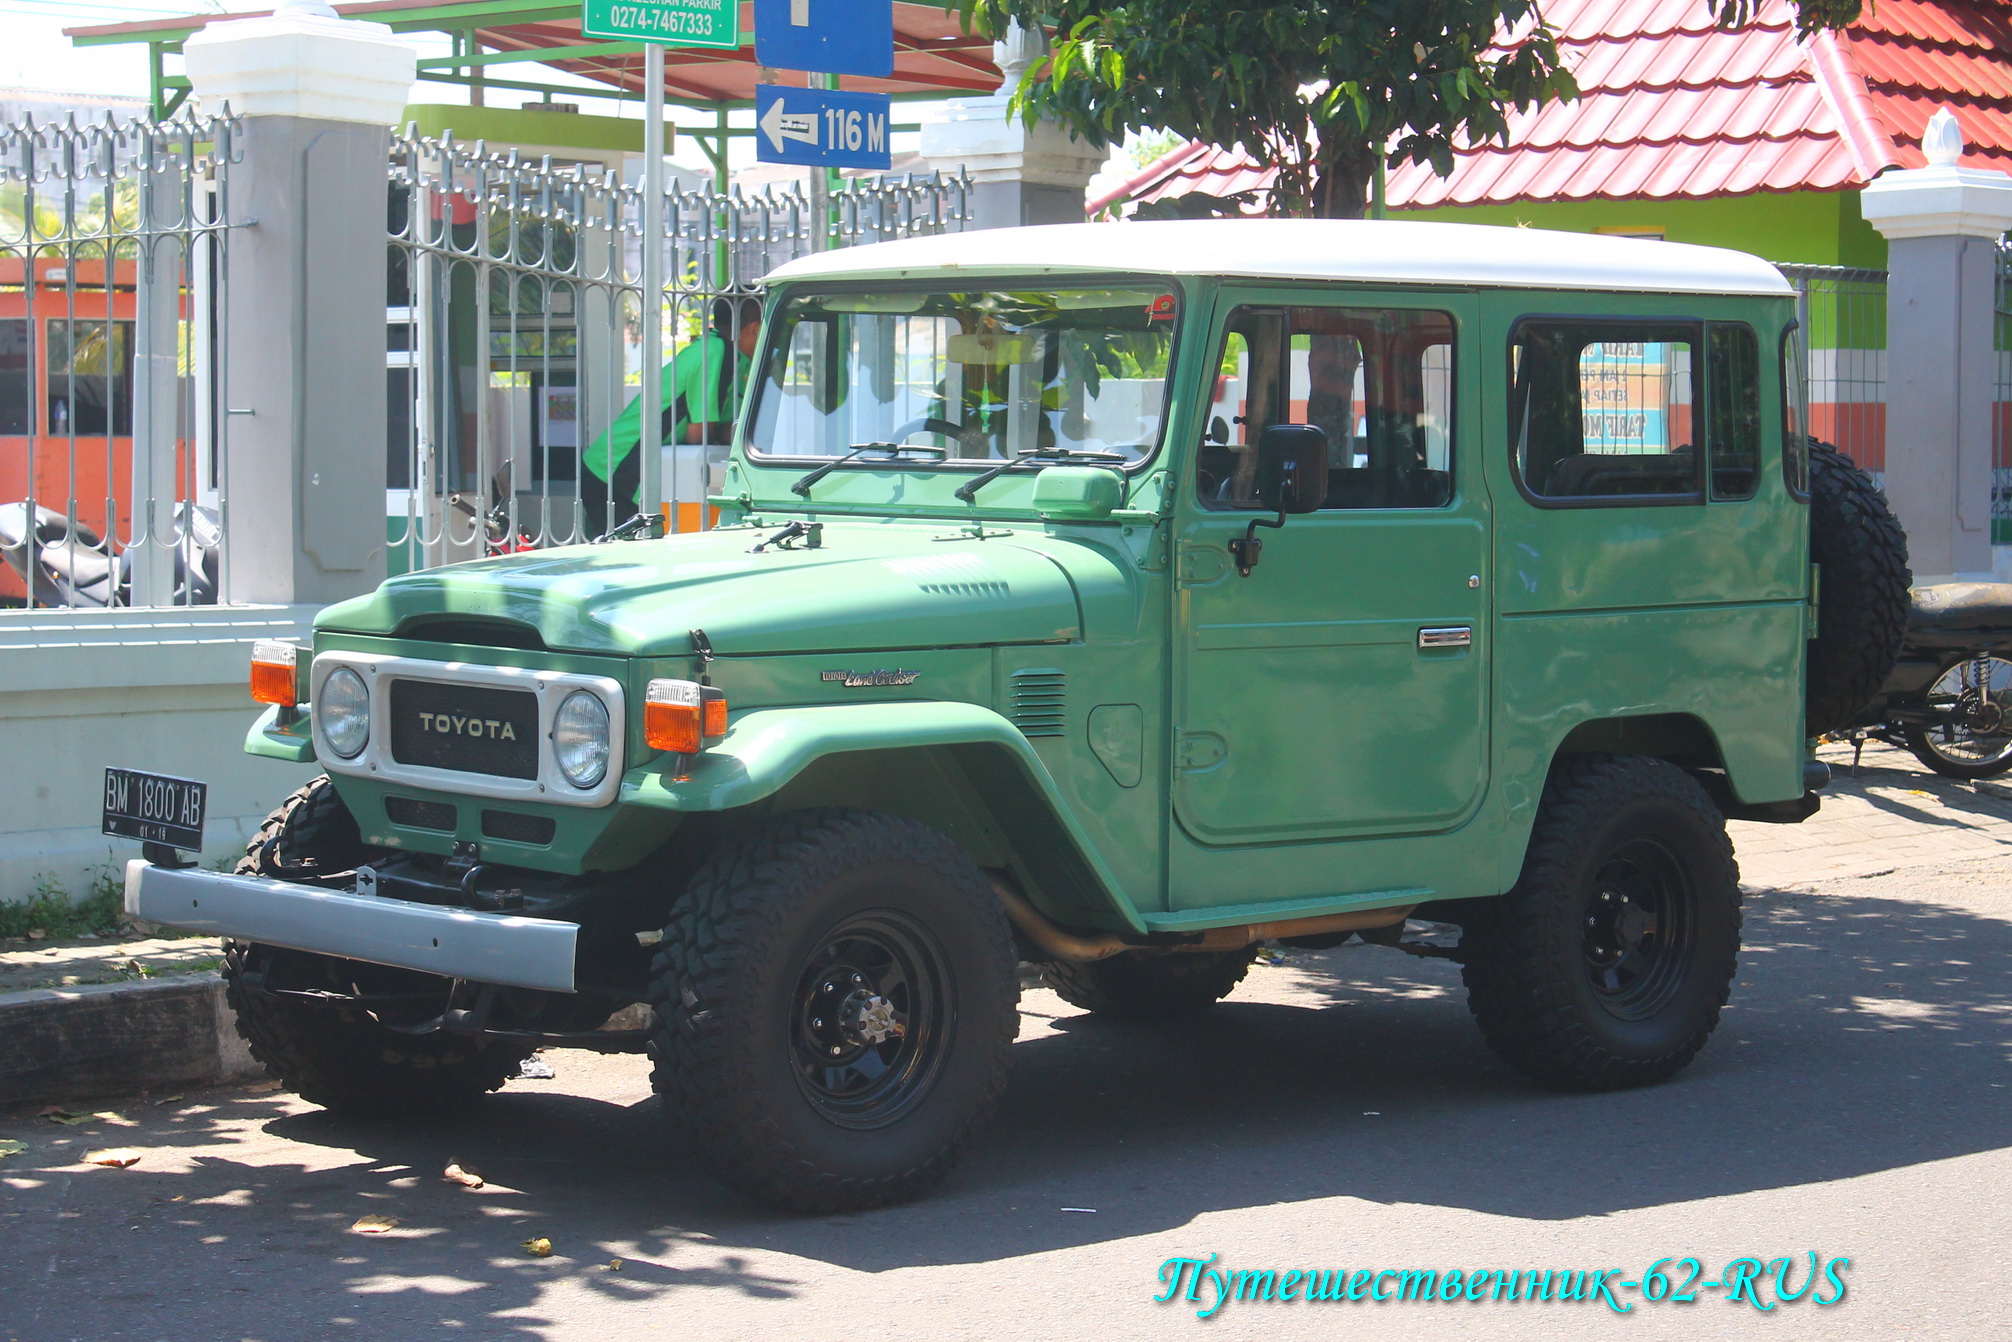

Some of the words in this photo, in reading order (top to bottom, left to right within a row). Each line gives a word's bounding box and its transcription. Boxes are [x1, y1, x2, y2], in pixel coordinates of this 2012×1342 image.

[611, 5, 713, 36] 0274-7467333
[825, 108, 863, 152] 116
[867, 112, 885, 153] M
[419, 712, 516, 741] TOYOTA
[106, 773, 129, 813] BM
[139, 778, 175, 821] 1800
[180, 785, 201, 826] AB
